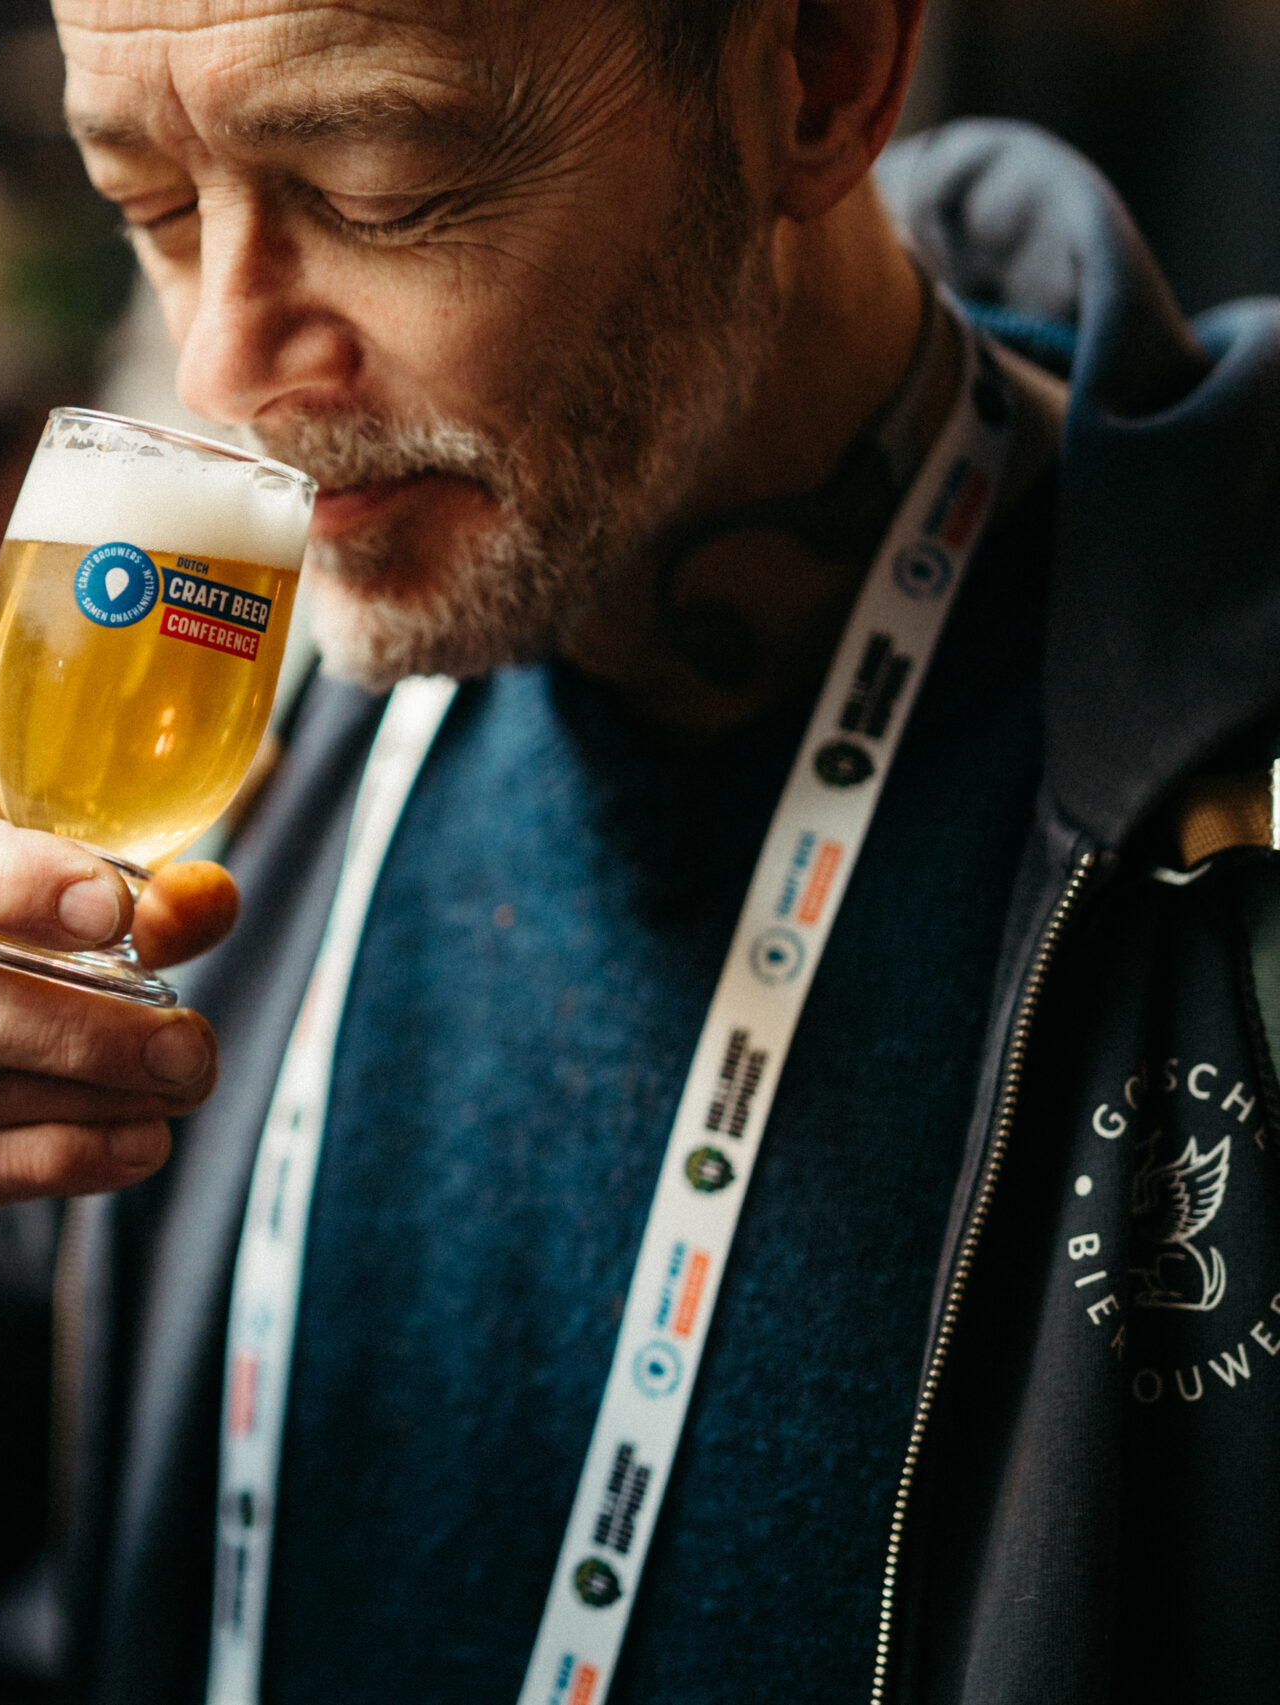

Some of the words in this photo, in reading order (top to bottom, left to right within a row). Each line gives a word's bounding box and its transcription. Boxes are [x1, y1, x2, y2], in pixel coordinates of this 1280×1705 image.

[78, 560, 95, 589] CRAFT
[93, 546, 142, 563] BROUWERS
[176, 556, 210, 575] DUTCH
[82, 597, 108, 621] SAMEN
[169, 576, 229, 612] CRAFT
[231, 595, 269, 625] BEER
[167, 613, 257, 655] CONFERENCE
